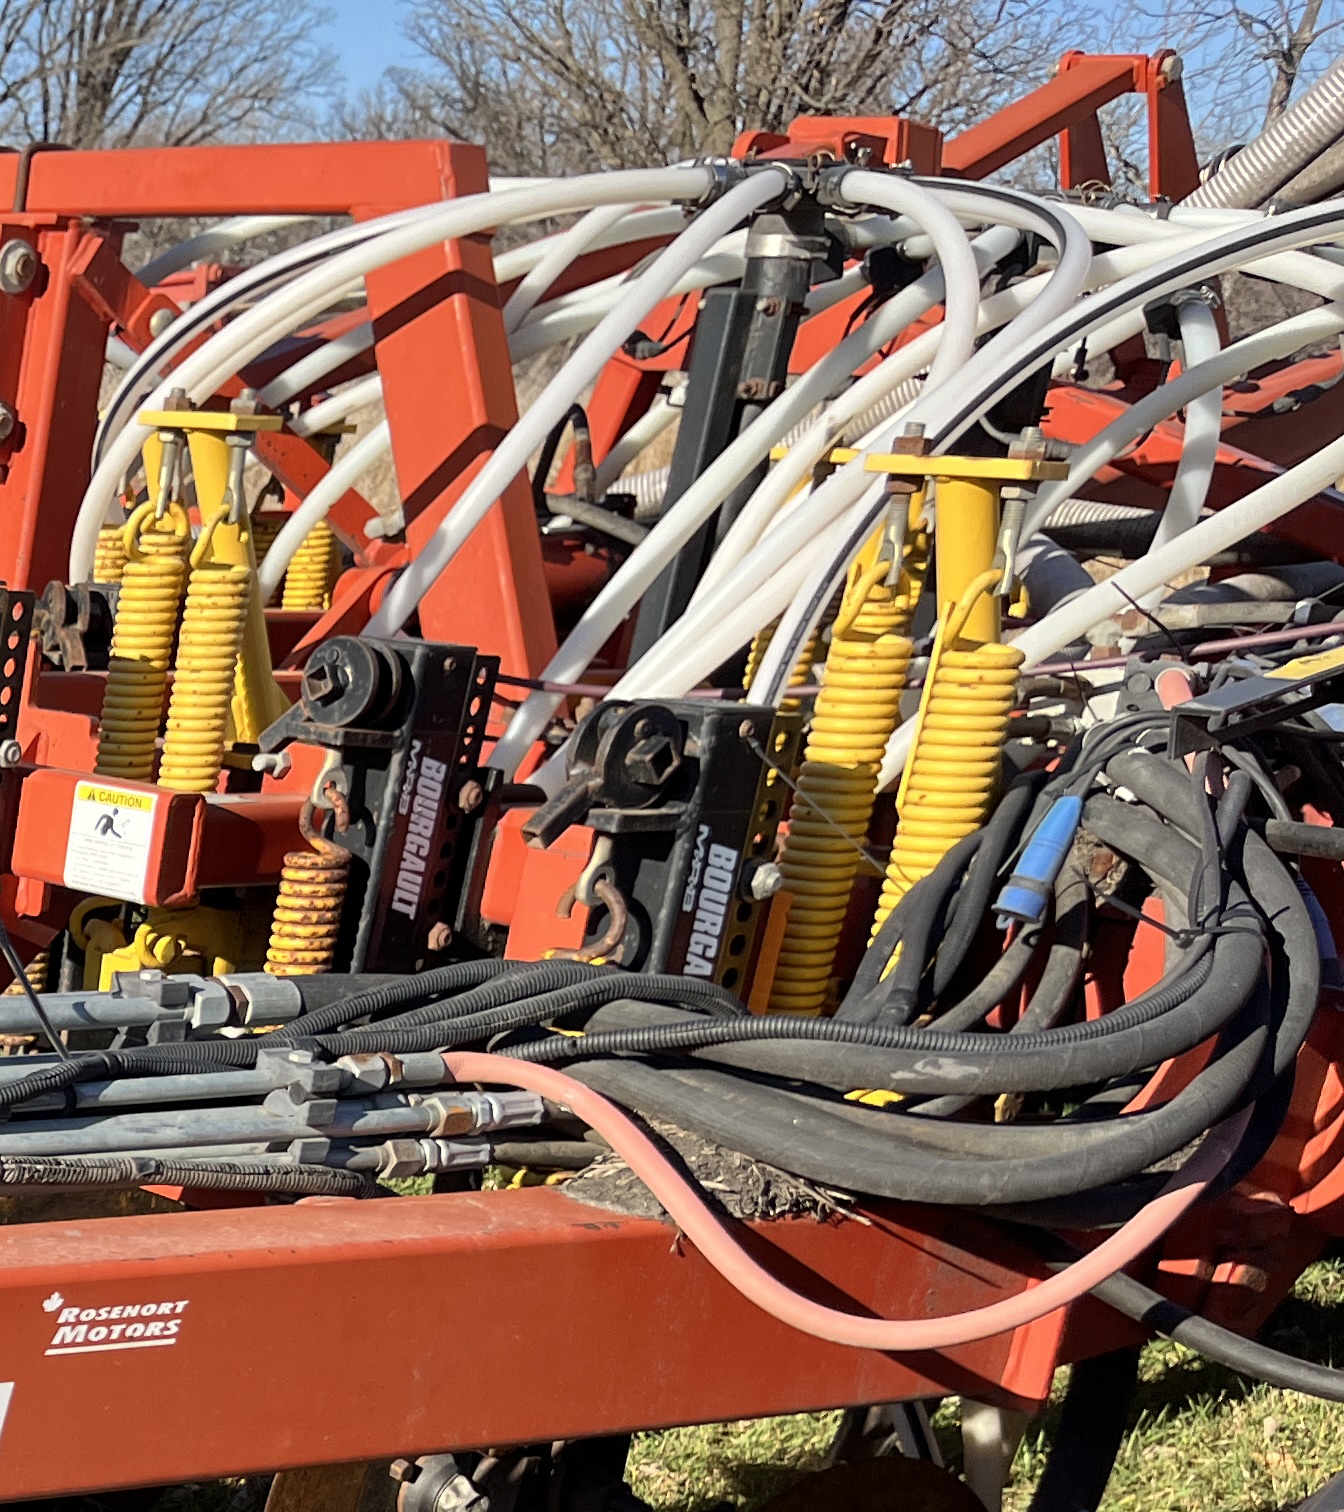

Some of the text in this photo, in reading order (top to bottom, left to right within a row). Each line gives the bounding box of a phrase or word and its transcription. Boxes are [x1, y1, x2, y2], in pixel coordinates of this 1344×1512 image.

[98, 791, 143, 809] CAUTION
[391, 756, 447, 921] BOURGAULT
[683, 843, 738, 976] BOURGA
[56, 1300, 190, 1324] ROSENORT
[50, 1319, 183, 1345] MOTORS
